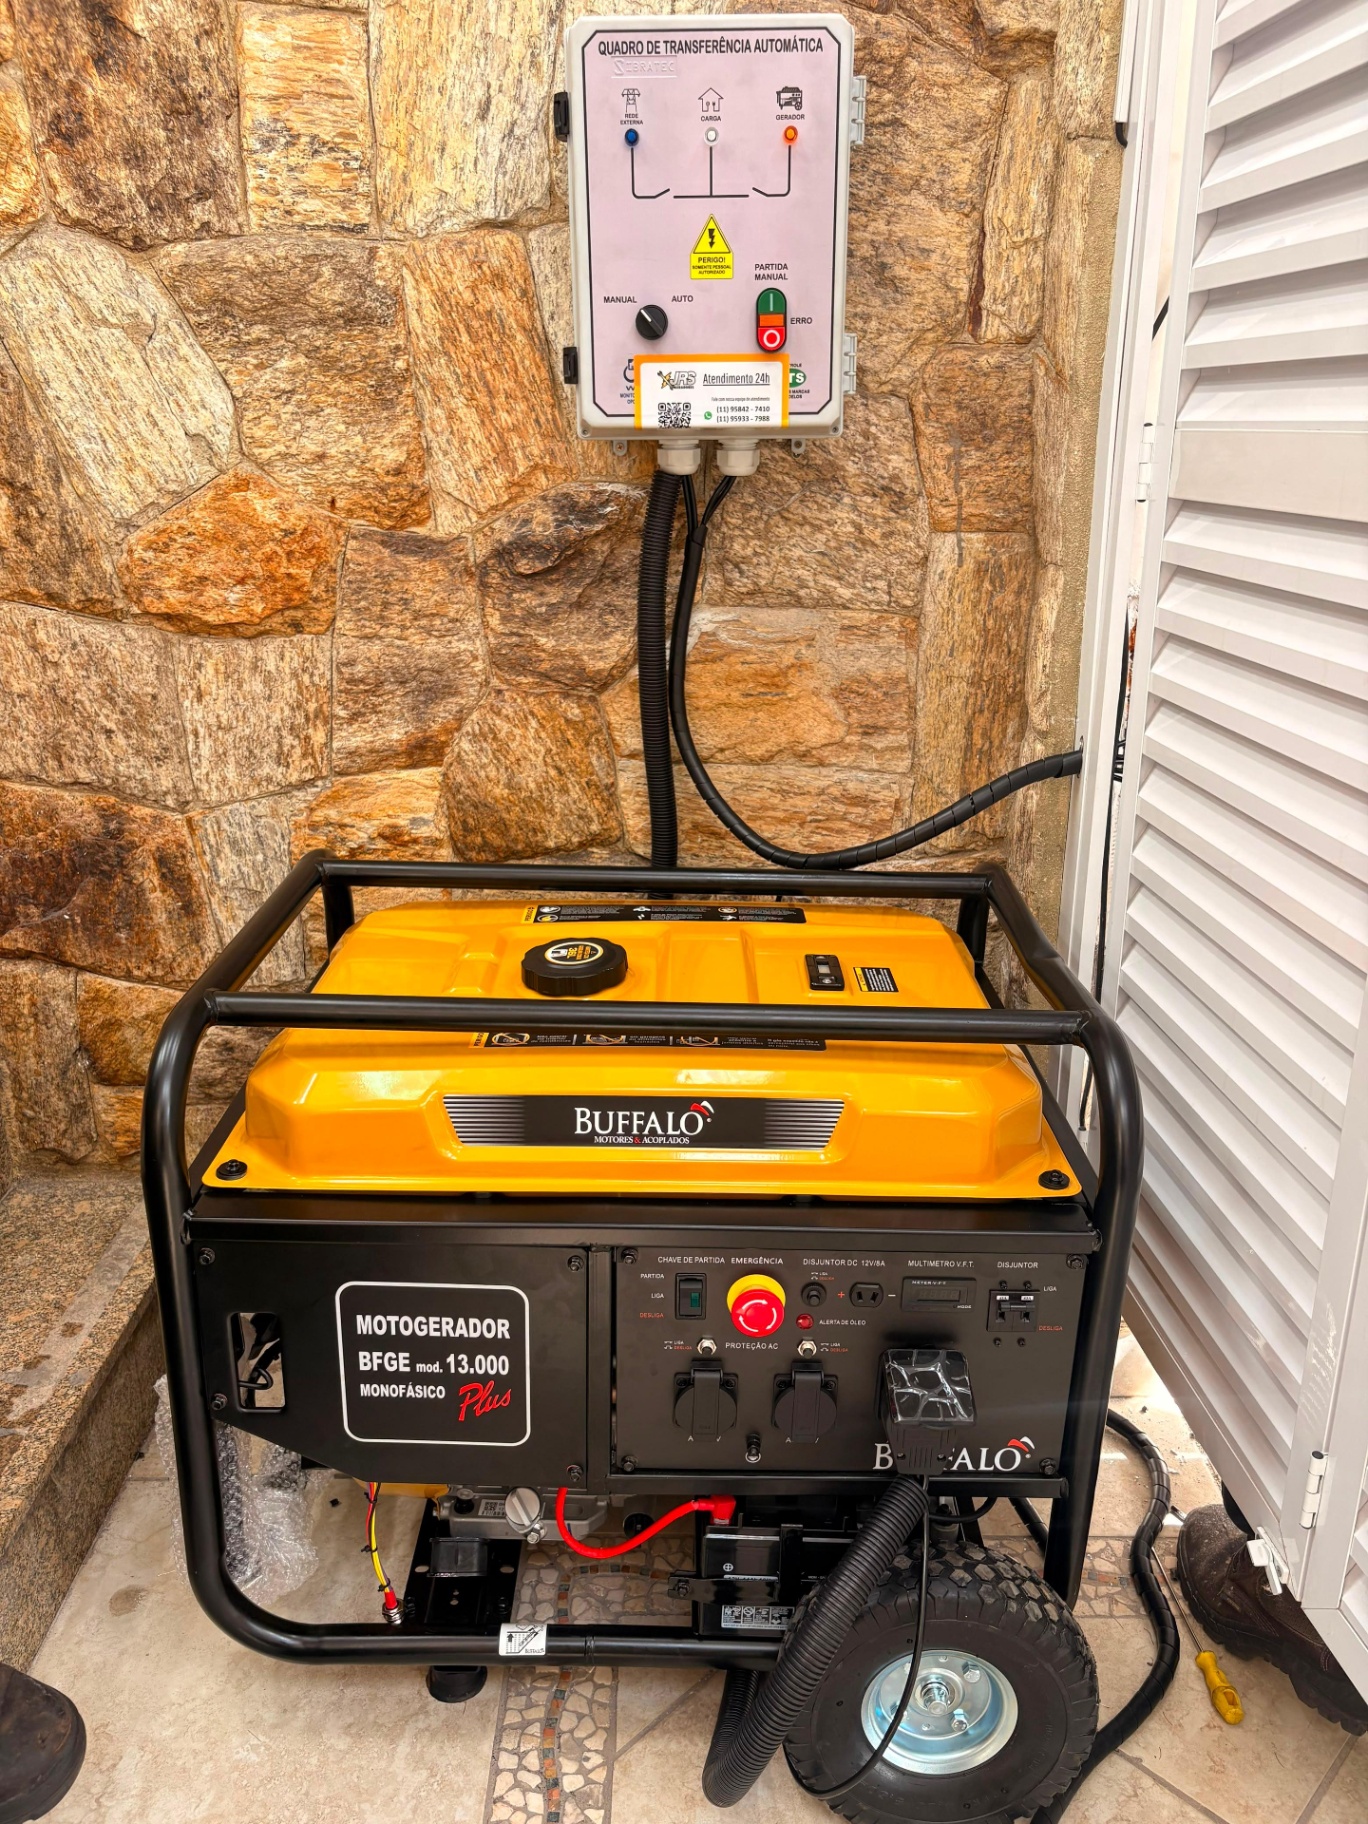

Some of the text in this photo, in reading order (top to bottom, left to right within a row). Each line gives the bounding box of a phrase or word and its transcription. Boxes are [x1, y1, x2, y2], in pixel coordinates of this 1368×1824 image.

[598, 35, 824, 56] QUADRO DE TRANSFERÊNCIA AUTOMÁTICA
[754, 263, 789, 271] PARTIDA
[754, 273, 789, 281] MANUAL
[603, 296, 638, 304] MANUAL
[671, 295, 694, 303] AUTO
[790, 316, 813, 325] ERRO
[669, 370, 697, 386] JRS
[702, 372, 771, 385] Atendimento 24h
[716, 415, 729, 423] (11)
[574, 1107, 704, 1136] BUFFALO
[594, 1135, 634, 1144] MOTORES
[642, 1136, 690, 1144] ACOPLADOS
[657, 1256, 682, 1264] CHAVE
[683, 1256, 694, 1264] DE
[731, 1256, 784, 1265] EMERGÊNCIA
[803, 1258, 886, 1267] DISJUNTOR DC 12V/8A
[907, 1260, 955, 1268] MULTIMETRO
[997, 1261, 1039, 1269] DISJUNTOR
[356, 1315, 511, 1339] MOTOGERADOR
[725, 1341, 779, 1350] PROTEÇÃO AC
[358, 1351, 509, 1375] BFGE mod. 13.000
[360, 1382, 446, 1399] MONOFÁSICO
[458, 1380, 512, 1421] Plus
[872, 1443, 1022, 1472] BALO
